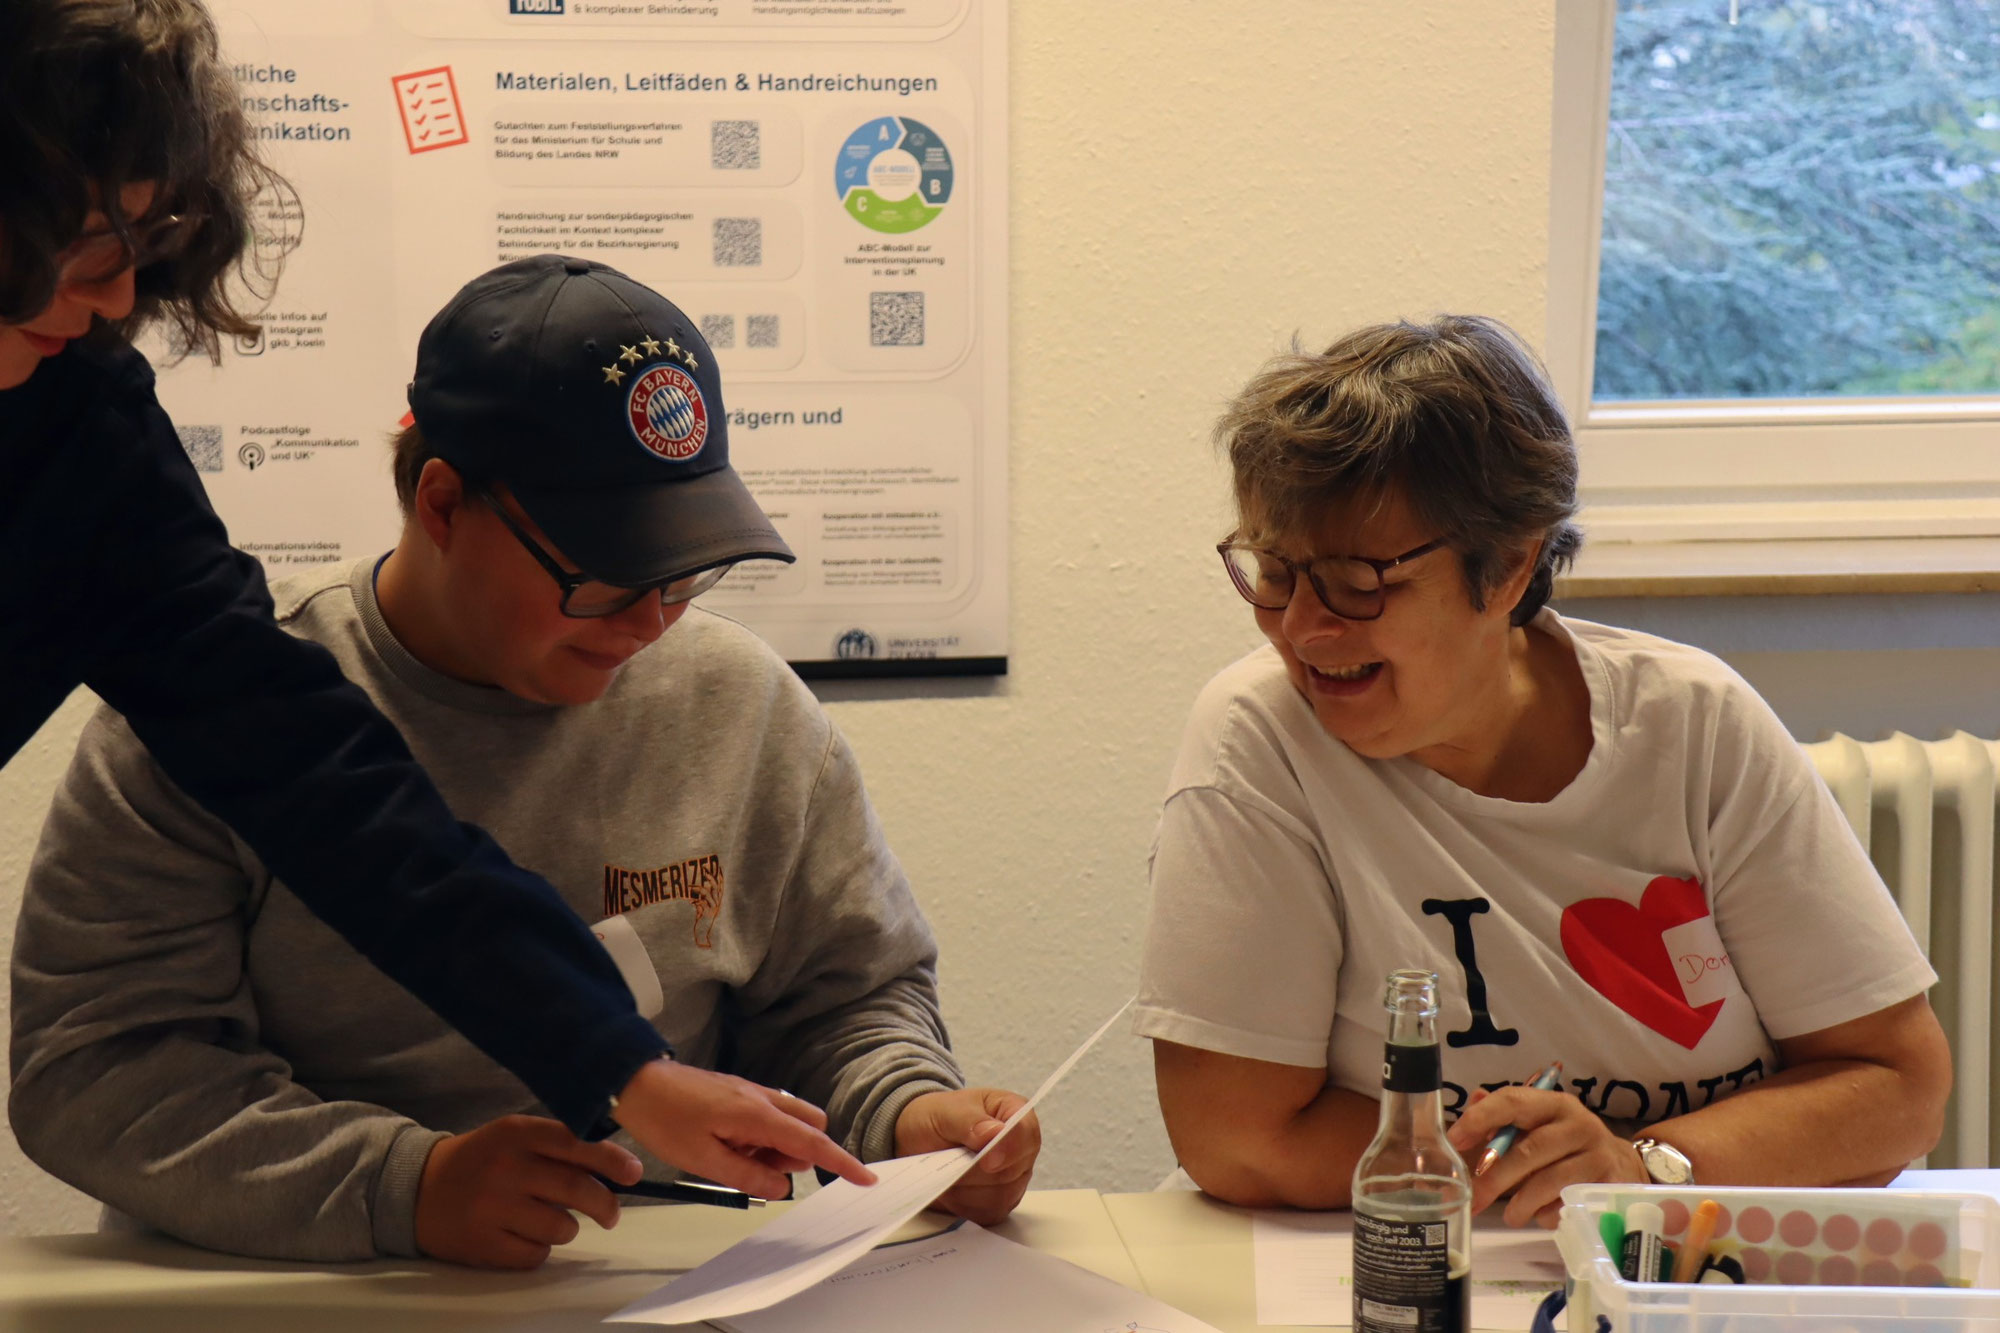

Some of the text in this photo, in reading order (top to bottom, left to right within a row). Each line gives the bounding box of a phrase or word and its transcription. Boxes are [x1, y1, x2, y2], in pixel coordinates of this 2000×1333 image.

[585, 4, 644, 16] komplexer
[649, 4, 719, 17] Behinderung
[234, 64, 297, 83] tliche
[496, 72, 938, 96] Materialen, Leitfäden & Handreichungen
[242, 94, 349, 112] nschafts-
[494, 121, 683, 132] Gutachten zum Feststellungsverfahren
[878, 124, 890, 141] A
[494, 135, 663, 144] für das Ministerium für Schule und
[495, 149, 619, 160] Bildung des Landes NRW
[930, 178, 941, 195] B
[856, 196, 867, 212] C
[497, 211, 694, 222] Handreichung zur sonderpädagogischen
[497, 225, 664, 236] Fachlichkeit im Kontext komplexer
[498, 240, 680, 250] Behinderung für die Bezirksregierung
[916, 244, 932, 252] zur
[843, 256, 946, 266] Interventionsplanung
[885, 268, 900, 276] der
[903, 268, 917, 276] UK
[281, 311, 308, 321] Infos
[310, 311, 328, 321] auf
[270, 325, 323, 336] Instagram
[633, 370, 699, 413] FC BAYERN
[726, 406, 843, 430] rägern und
[240, 425, 311, 436] Podcastfolge
[640, 418, 706, 456] MÜNCHEN
[271, 451, 291, 460] und
[239, 541, 341, 551] Informationsvideos
[268, 554, 283, 563] für
[1421, 896, 1520, 1048] I
[1392, 1224, 1409, 1234] und
[1399, 1237, 1422, 1246] 2003.
